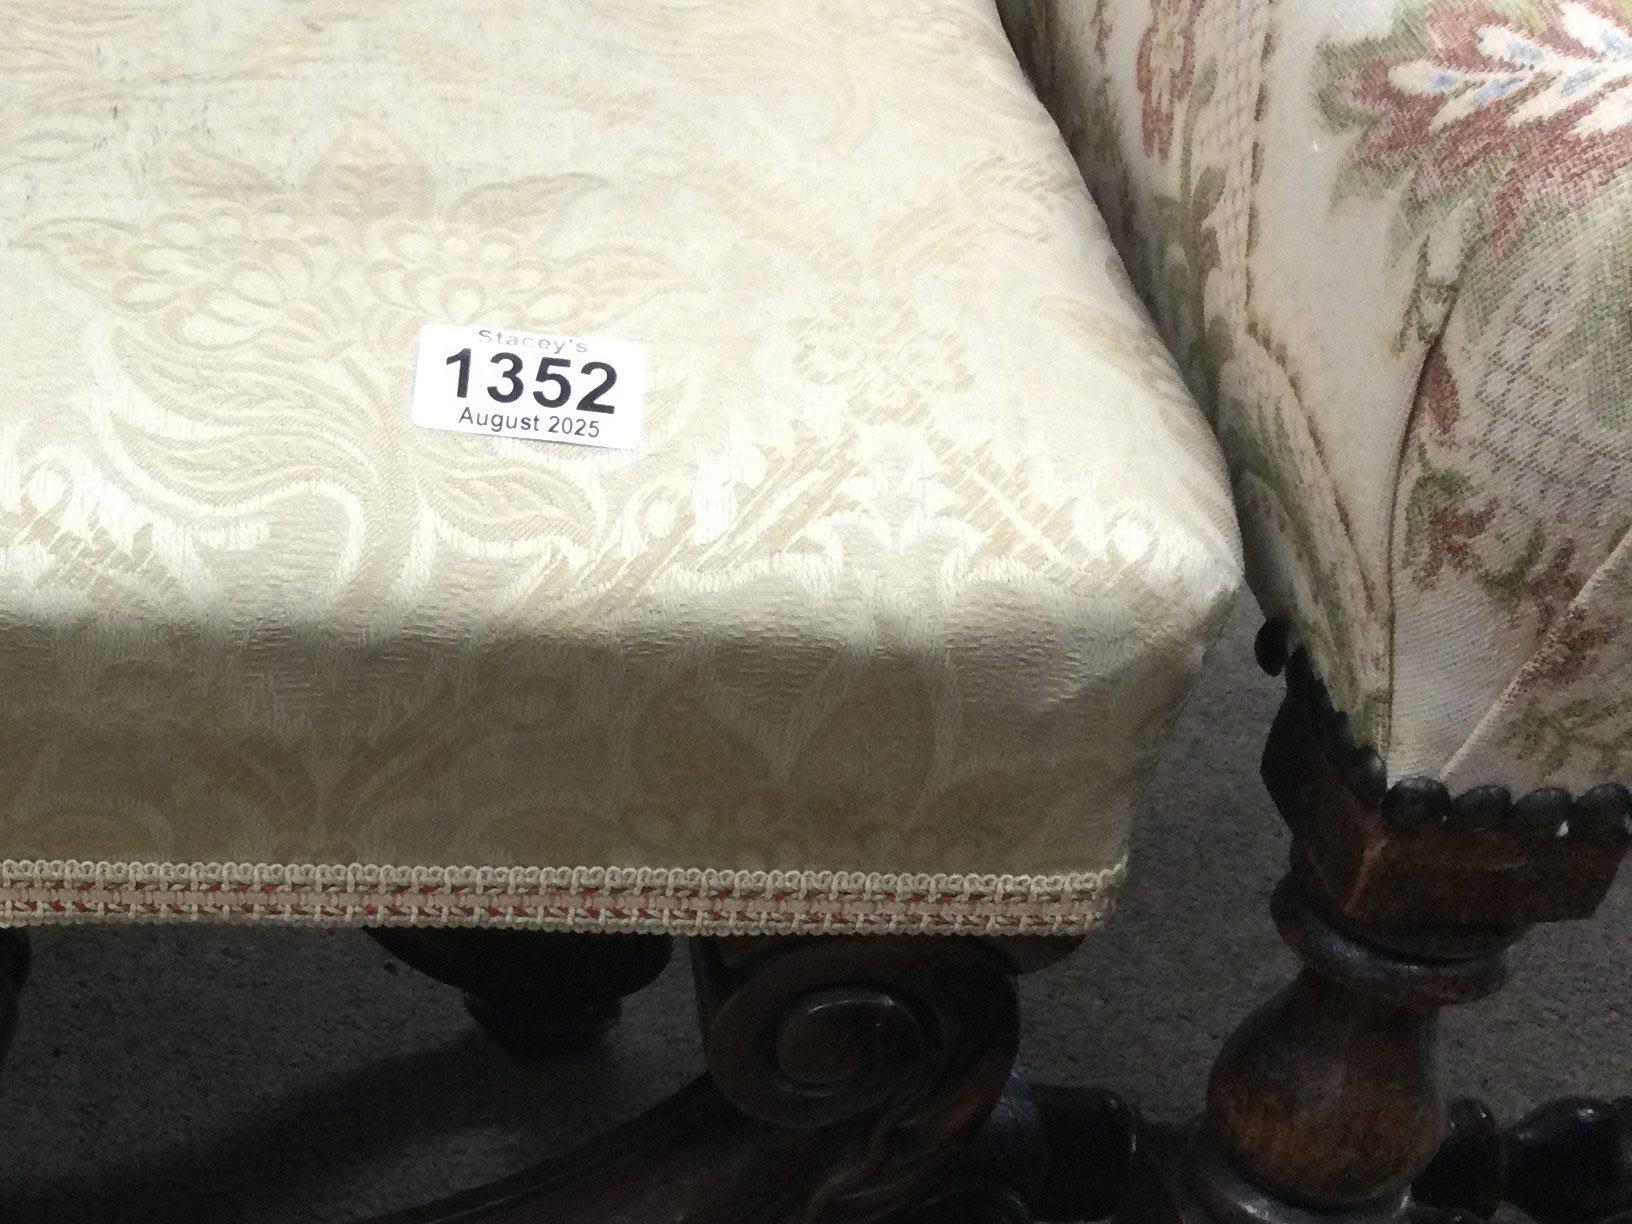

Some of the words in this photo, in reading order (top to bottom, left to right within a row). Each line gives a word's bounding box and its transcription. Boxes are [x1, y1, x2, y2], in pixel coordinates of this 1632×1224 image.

[478, 329, 588, 354] Stacey's
[445, 347, 618, 414] 1352
[458, 406, 540, 432] August
[548, 414, 600, 438] 2025
